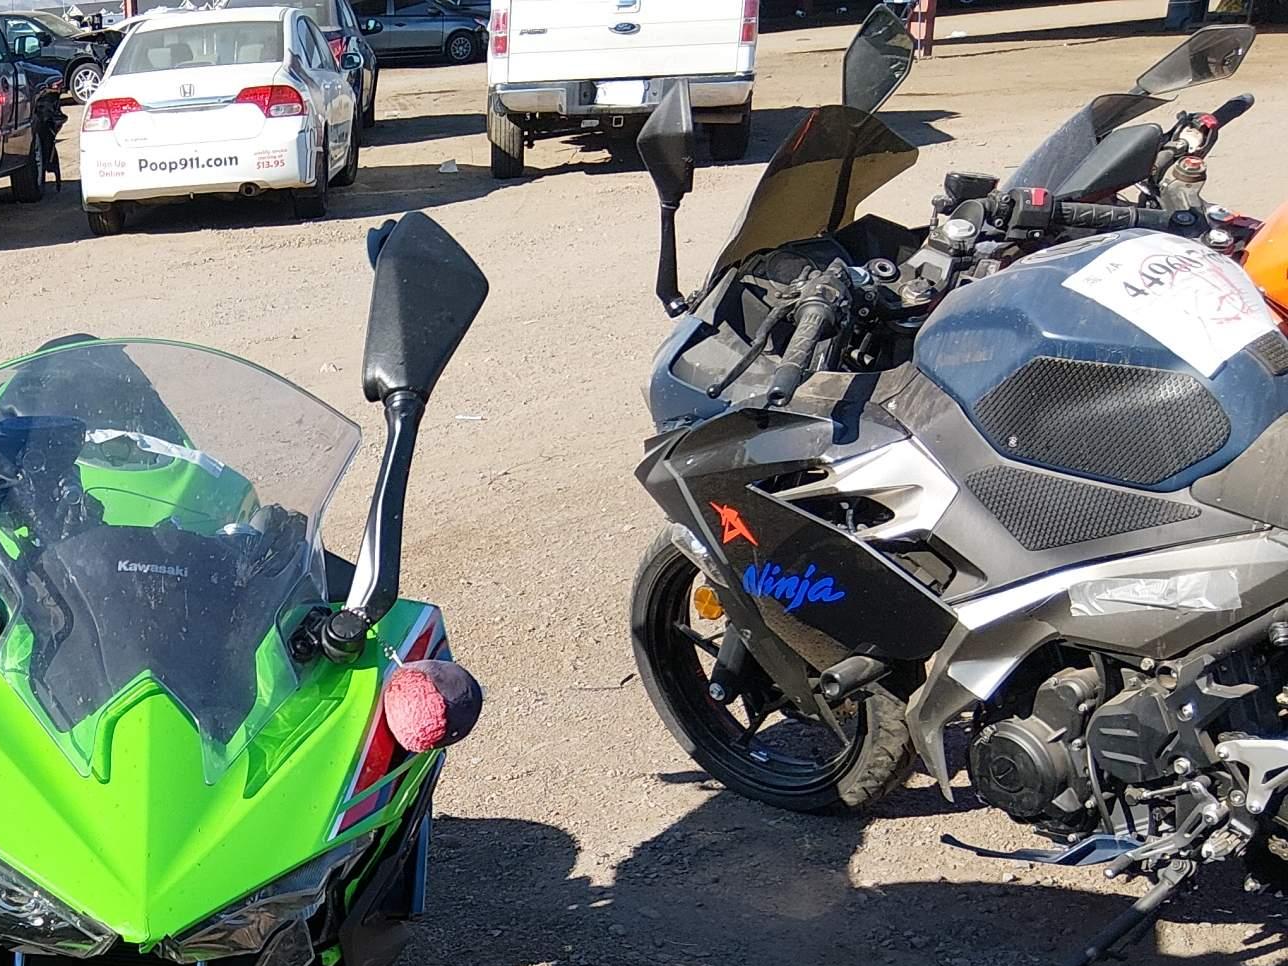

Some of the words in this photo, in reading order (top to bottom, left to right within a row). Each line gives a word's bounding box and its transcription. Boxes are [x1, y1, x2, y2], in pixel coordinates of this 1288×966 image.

[138, 155, 239, 173] Poop911.com
[256, 159, 286, 170] $13.95
[98, 169, 126, 178] Online
[117, 559, 189, 578] Kawasaki
[742, 562, 846, 614] Ninja
